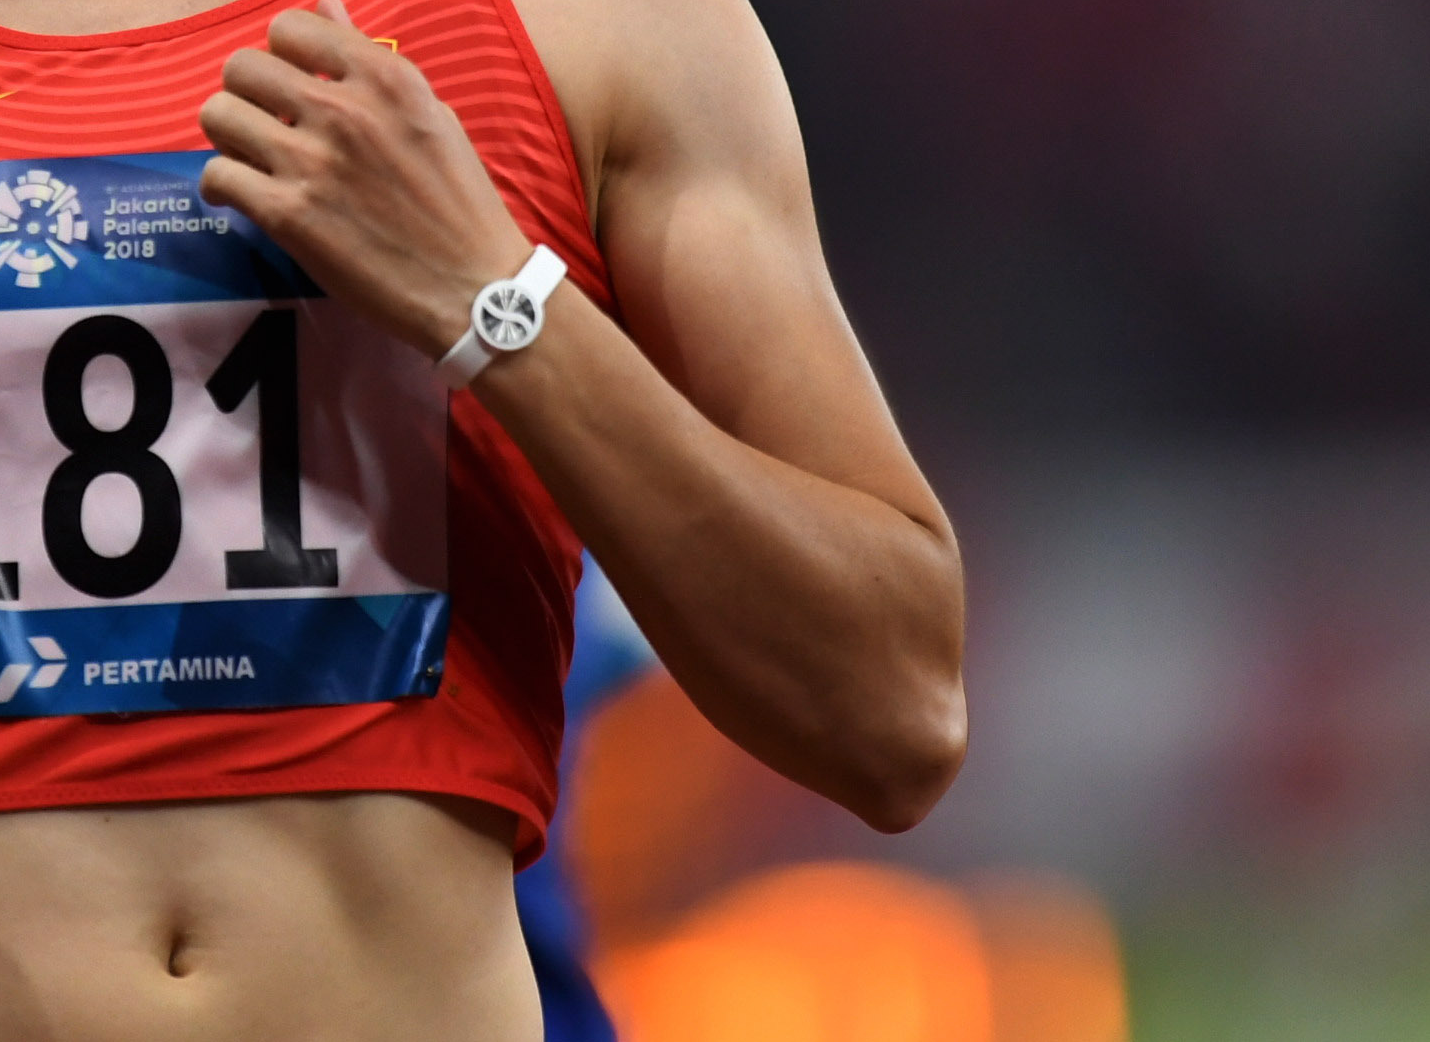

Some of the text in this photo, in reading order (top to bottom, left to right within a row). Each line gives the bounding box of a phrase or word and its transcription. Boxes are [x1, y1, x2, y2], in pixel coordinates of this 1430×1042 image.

[103, 197, 190, 215] Jakarta
[103, 217, 228, 235] Palembang
[103, 239, 155, 260] 2018
[83, 655, 256, 686] PERTAMINA
